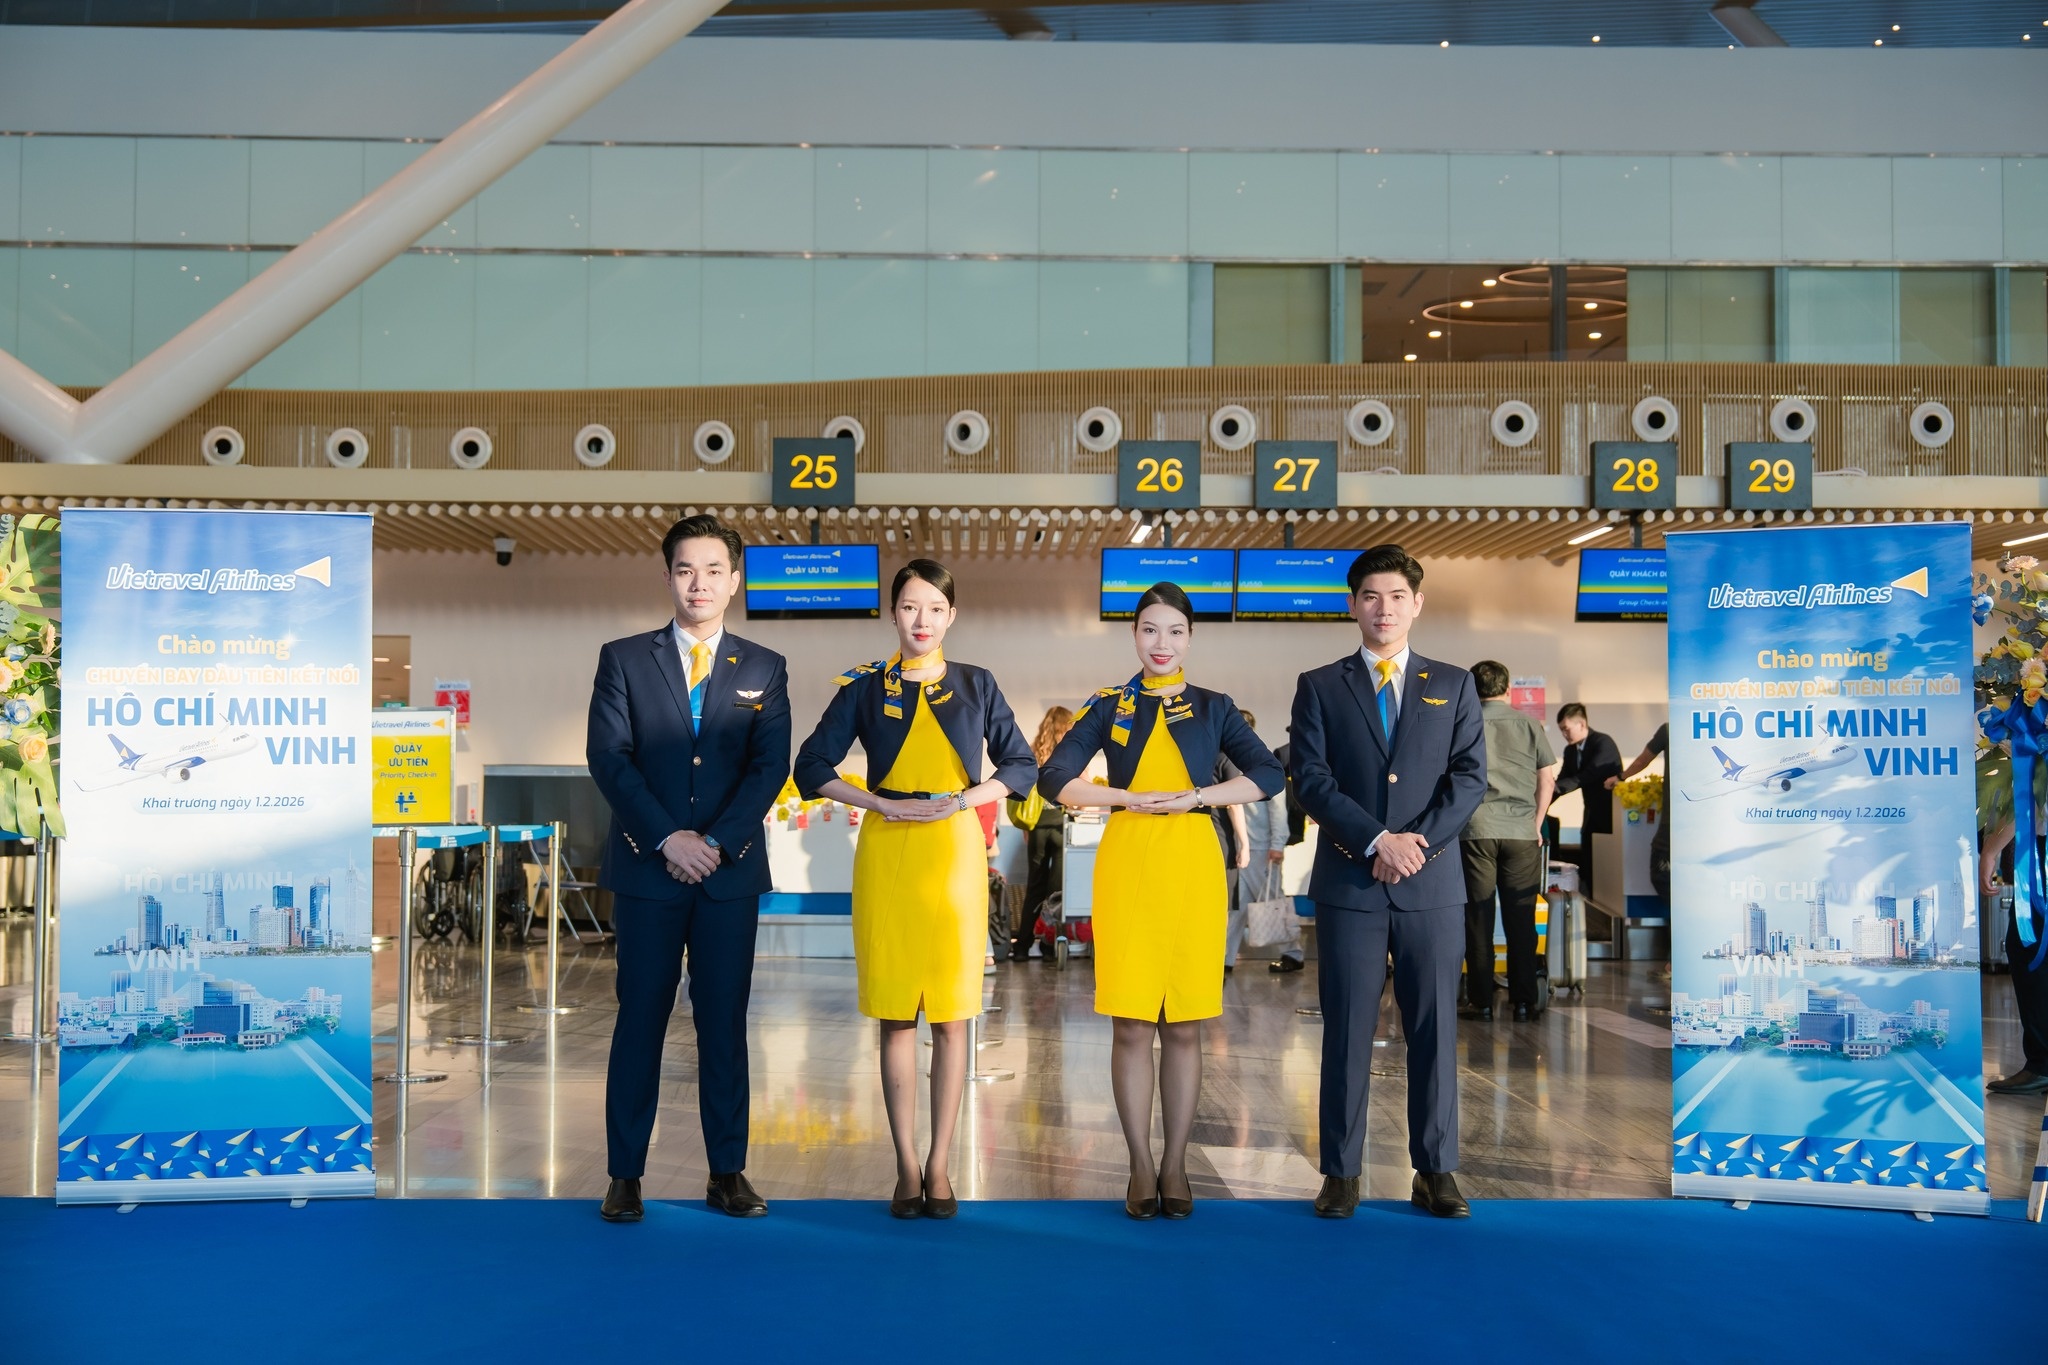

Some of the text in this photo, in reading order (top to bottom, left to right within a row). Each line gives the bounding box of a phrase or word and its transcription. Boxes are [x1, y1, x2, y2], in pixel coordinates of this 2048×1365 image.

[790, 454, 838, 489] 25
[1136, 457, 1184, 492] 26
[1273, 457, 1320, 492] 27
[1612, 458, 1660, 492] 28
[1748, 459, 1795, 493] 29
[106, 563, 296, 594] Vietravel Airlines
[1708, 583, 1892, 609] Vietravel Airlines
[157, 634, 290, 661] Chào mừng
[1757, 648, 1888, 672] Chào mừng
[86, 663, 161, 685] CHUYẾN
[163, 667, 200, 684] BAY
[203, 663, 243, 685] ĐẦU
[245, 664, 286, 684] TIÊN
[289, 663, 324, 684] KẾT
[1691, 676, 1761, 699] CHUYẾN
[1764, 680, 1799, 698] BAY
[1802, 675, 1841, 697] ĐẦU
[1843, 677, 1887, 696] TIÊN
[1889, 674, 1924, 695] KẾT
[87, 686, 327, 727] HỒ CHÍ MINH
[404, 720, 431, 729] Airlines
[1692, 701, 1926, 740] HỒ CHÍ MINH
[265, 736, 356, 765] VINH
[1864, 746, 1958, 776] VINH
[380, 772, 406, 780] Priority
[142, 796, 305, 811] Khai trương ngày 1.2.2026
[1745, 806, 1906, 821] Khai trương ngày 1.2.2026
[224, 871, 294, 892] MINH
[126, 950, 201, 973] VINH
[1731, 955, 1804, 978] VINH
